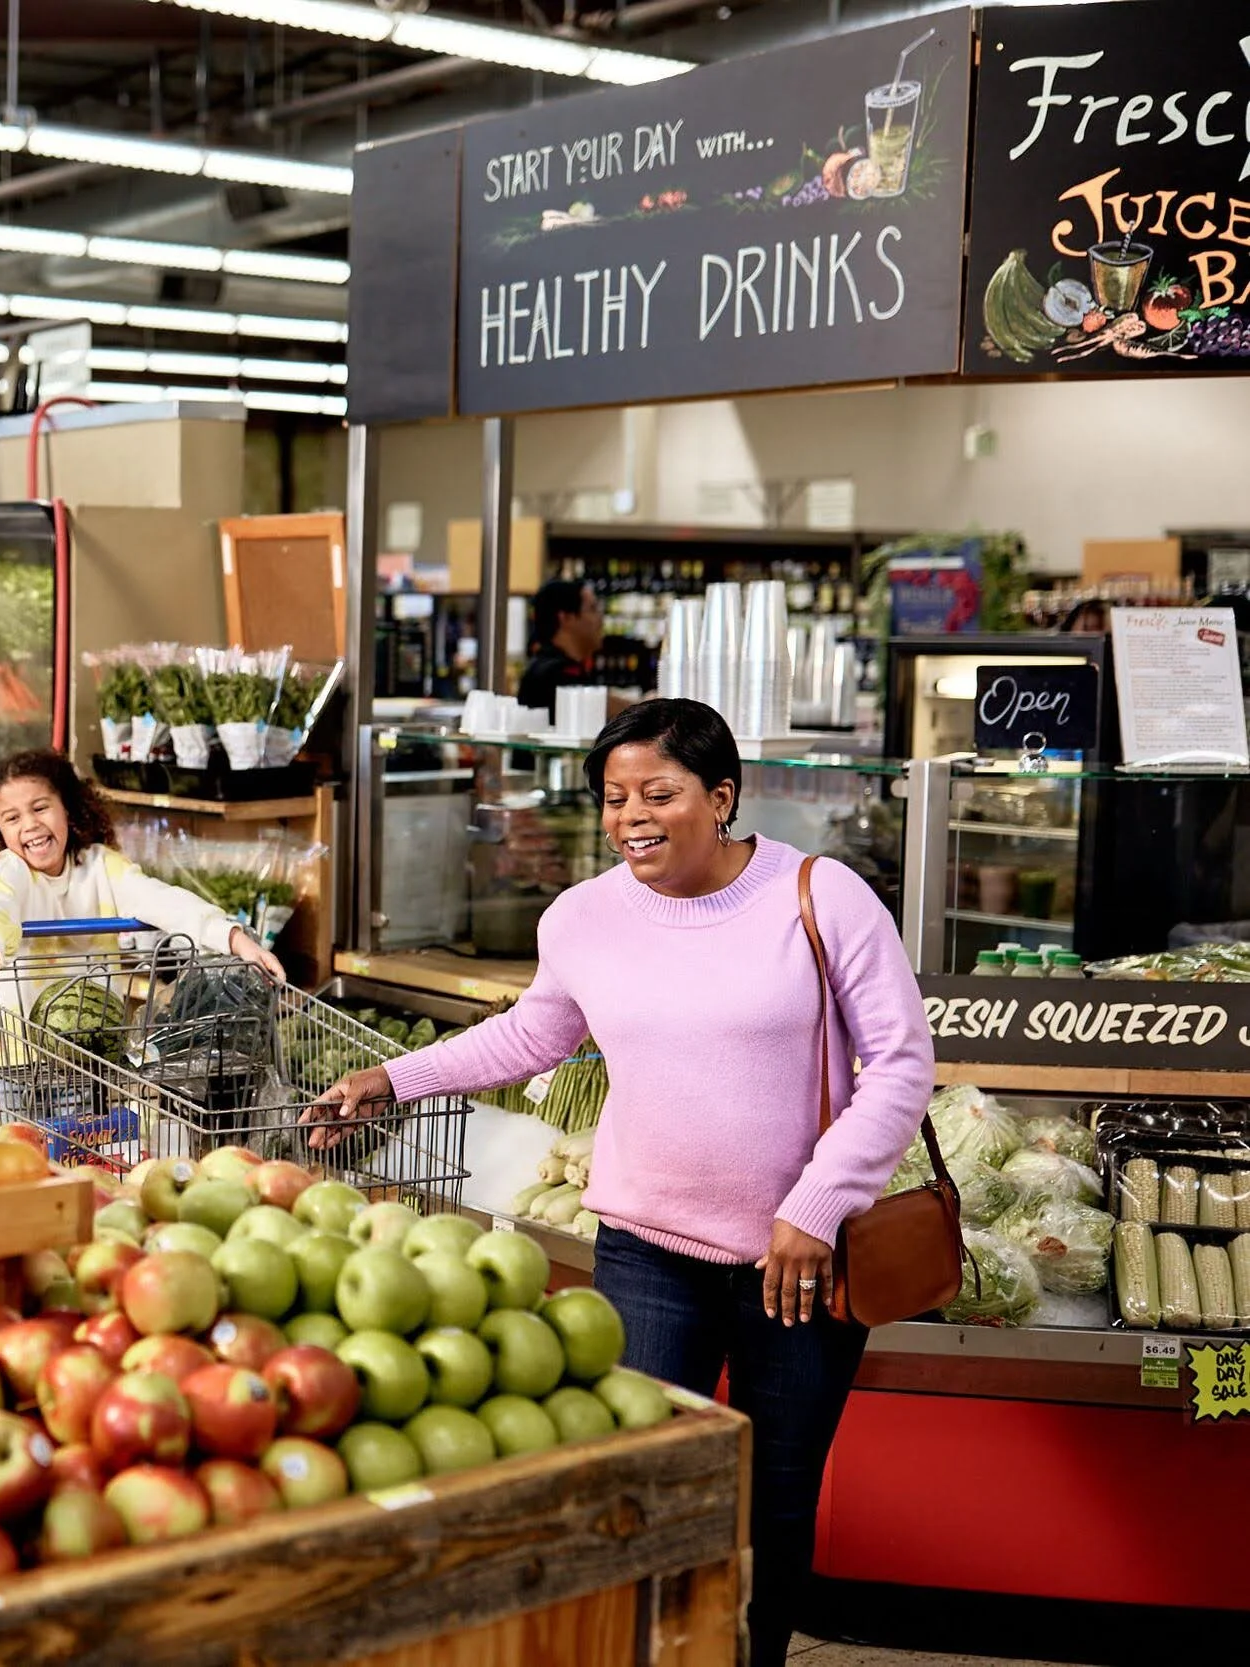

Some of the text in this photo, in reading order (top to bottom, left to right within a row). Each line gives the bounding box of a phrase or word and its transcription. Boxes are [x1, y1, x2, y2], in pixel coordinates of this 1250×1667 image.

[484, 146, 554, 203] START
[562, 131, 624, 187] YOUR
[634, 118, 684, 173] DAY
[1051, 167, 1250, 257] JUICE
[480, 225, 906, 368] HEALTHY DRINKS
[979, 675, 1071, 730] Open
[923, 996, 1019, 1040] RESH
[1023, 1000, 1228, 1046] SQUEEZED
[1145, 1345, 1176, 1355] $6.49
[1216, 1352, 1246, 1367] ONE
[1216, 1365, 1245, 1382] DAY
[1211, 1381, 1248, 1401] SALE
